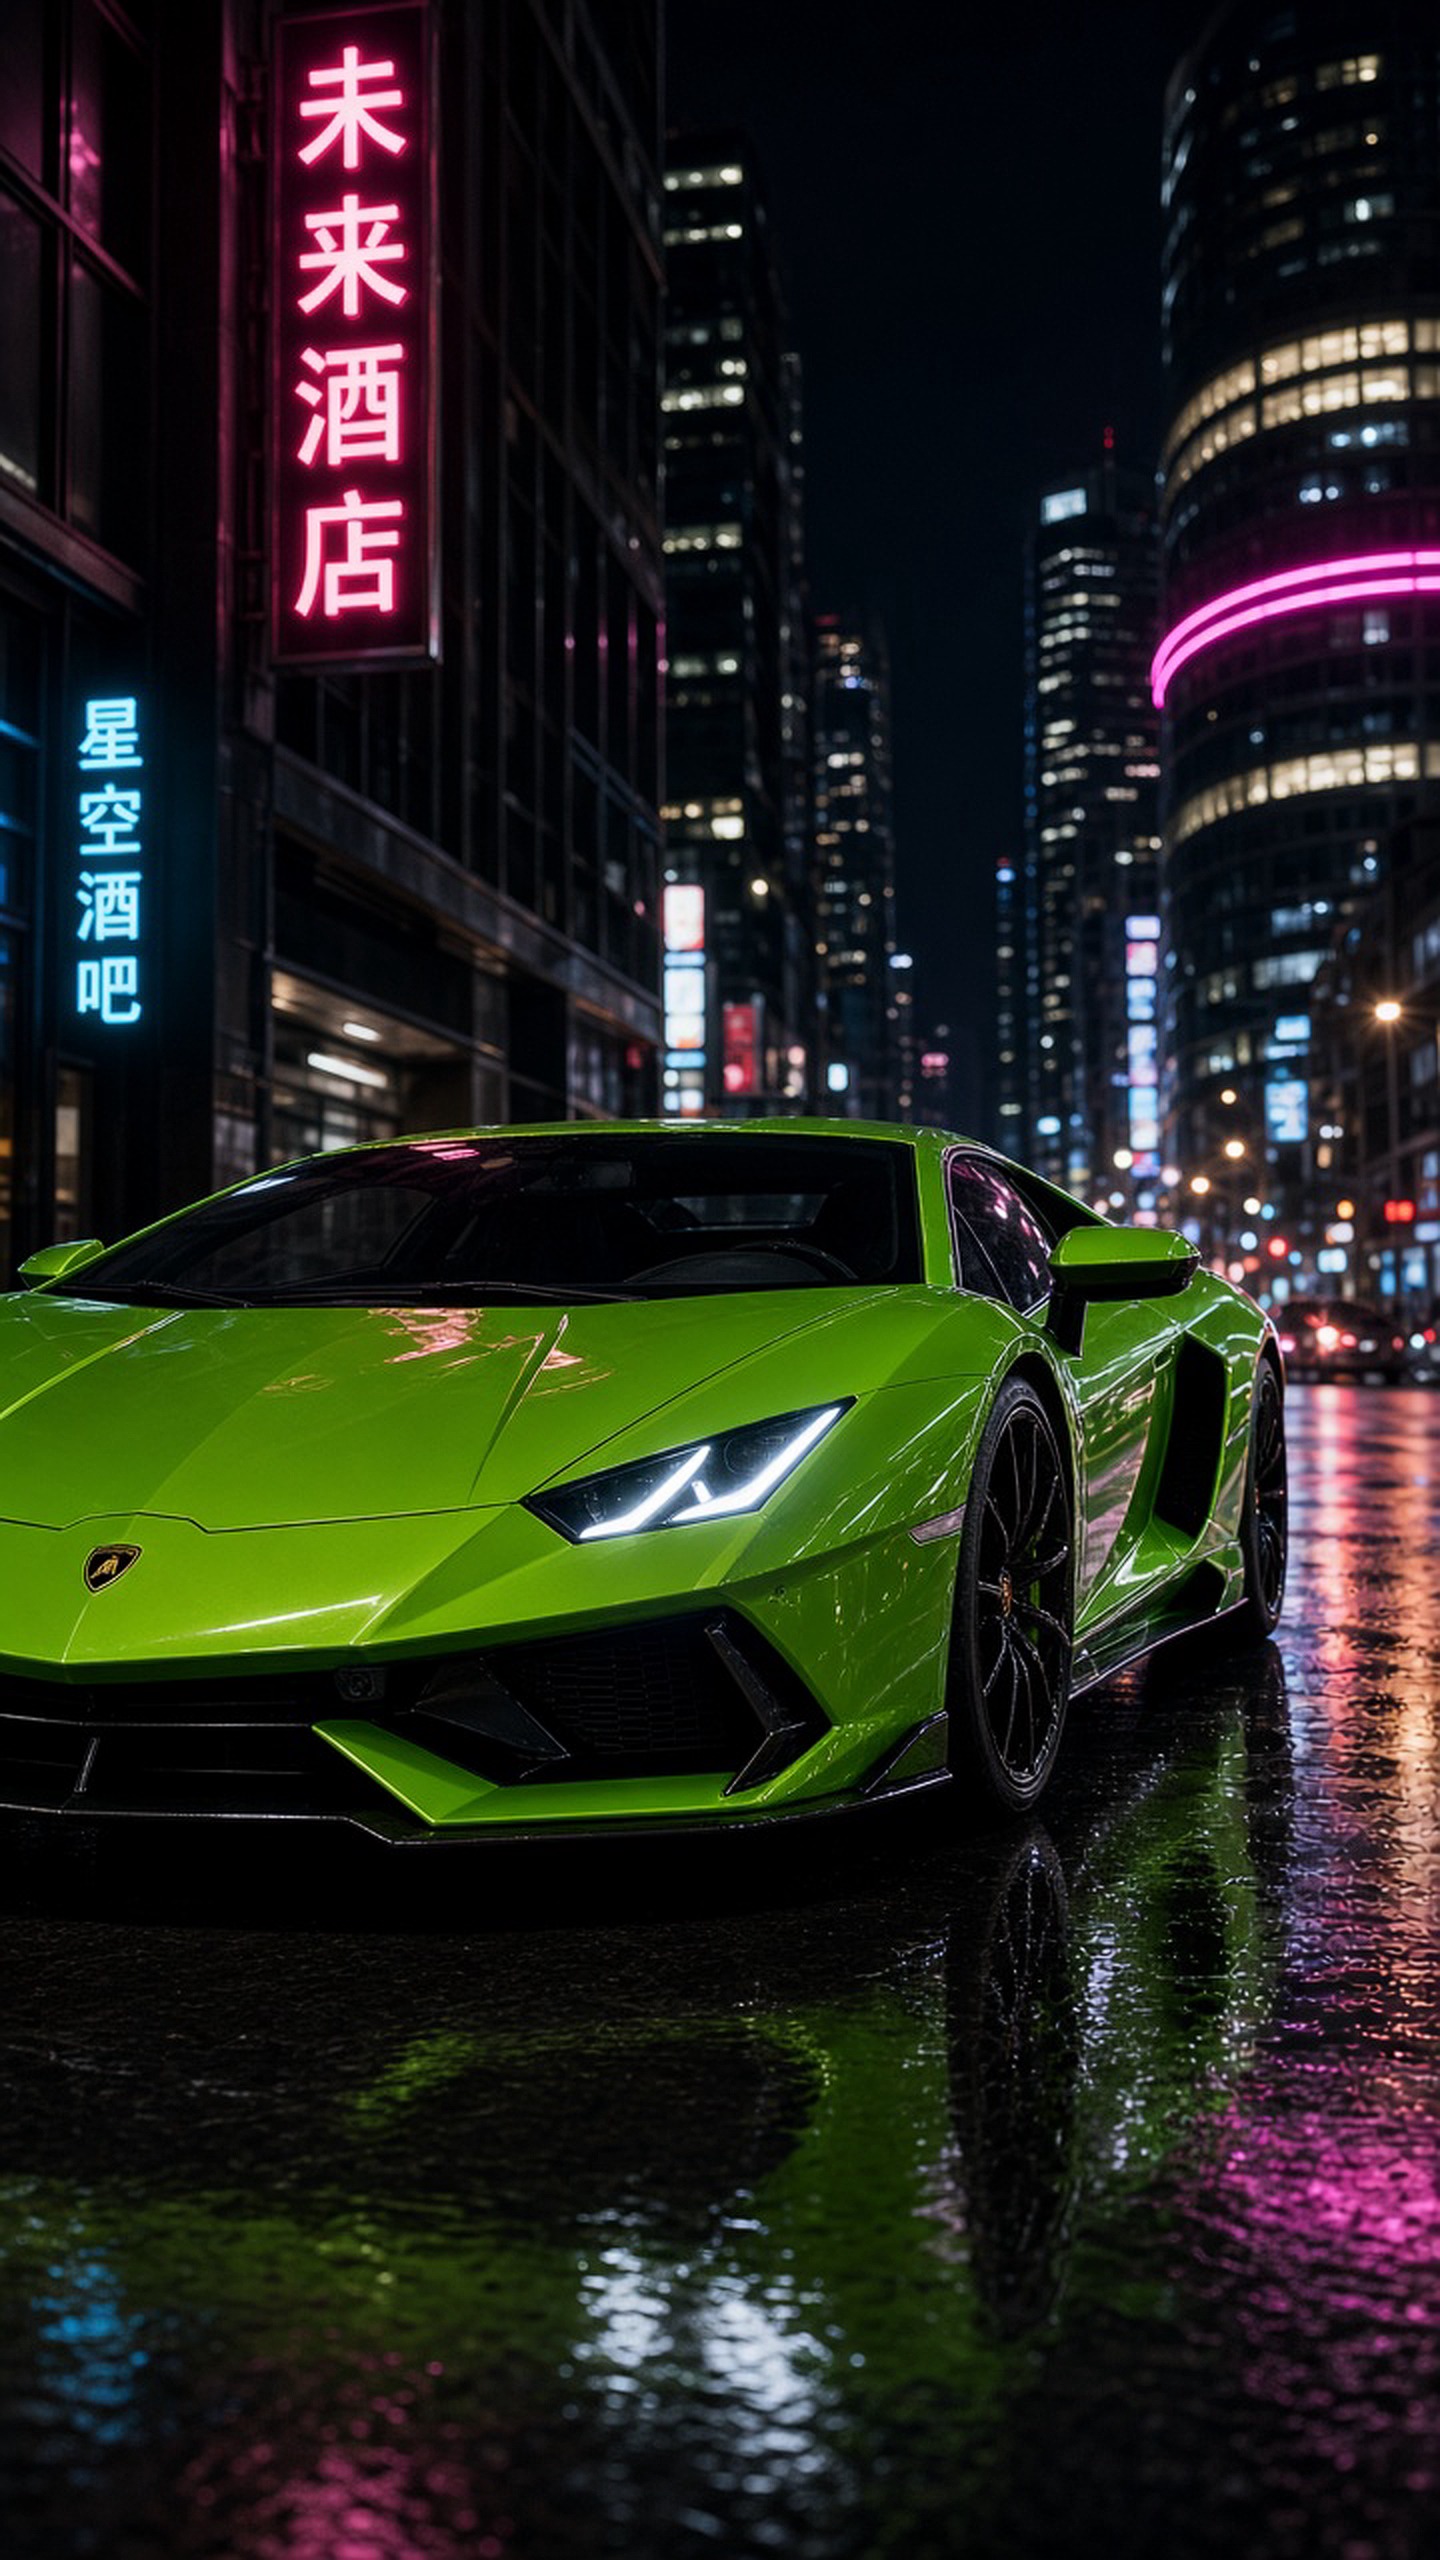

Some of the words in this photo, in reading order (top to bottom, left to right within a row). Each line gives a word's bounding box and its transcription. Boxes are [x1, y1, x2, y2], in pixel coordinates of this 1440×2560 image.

[295, 46, 409, 618] 未来酒店
[75, 697, 143, 1024] 星空酒吧
